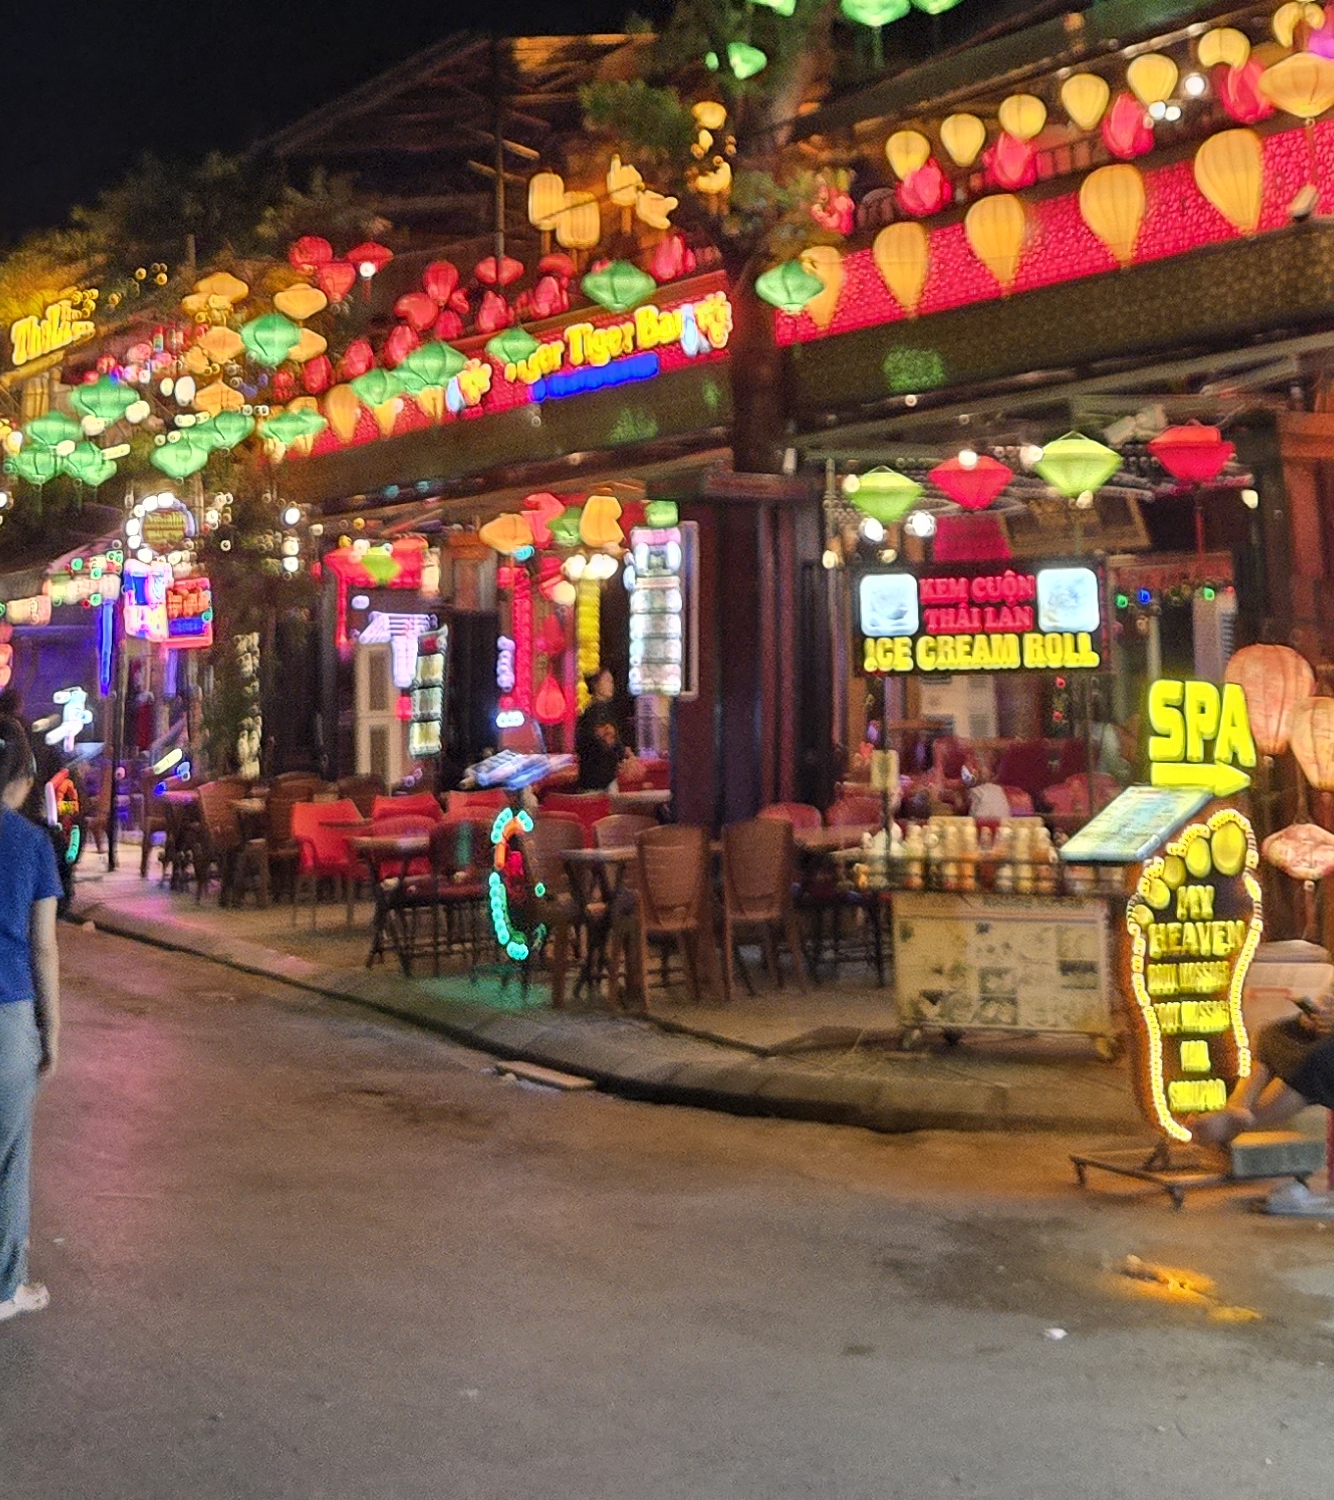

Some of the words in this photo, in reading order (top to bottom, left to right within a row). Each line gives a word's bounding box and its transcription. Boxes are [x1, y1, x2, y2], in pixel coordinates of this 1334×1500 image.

[564, 322, 635, 367] Tiger
[918, 577, 969, 605] KEM
[982, 606, 1034, 634] LAN
[863, 636, 914, 672] ICE
[916, 634, 1021, 671] CREAM
[1023, 631, 1100, 669] ROLL
[1148, 680, 1256, 768] SPA
[1148, 920, 1245, 959] HEAVEN
